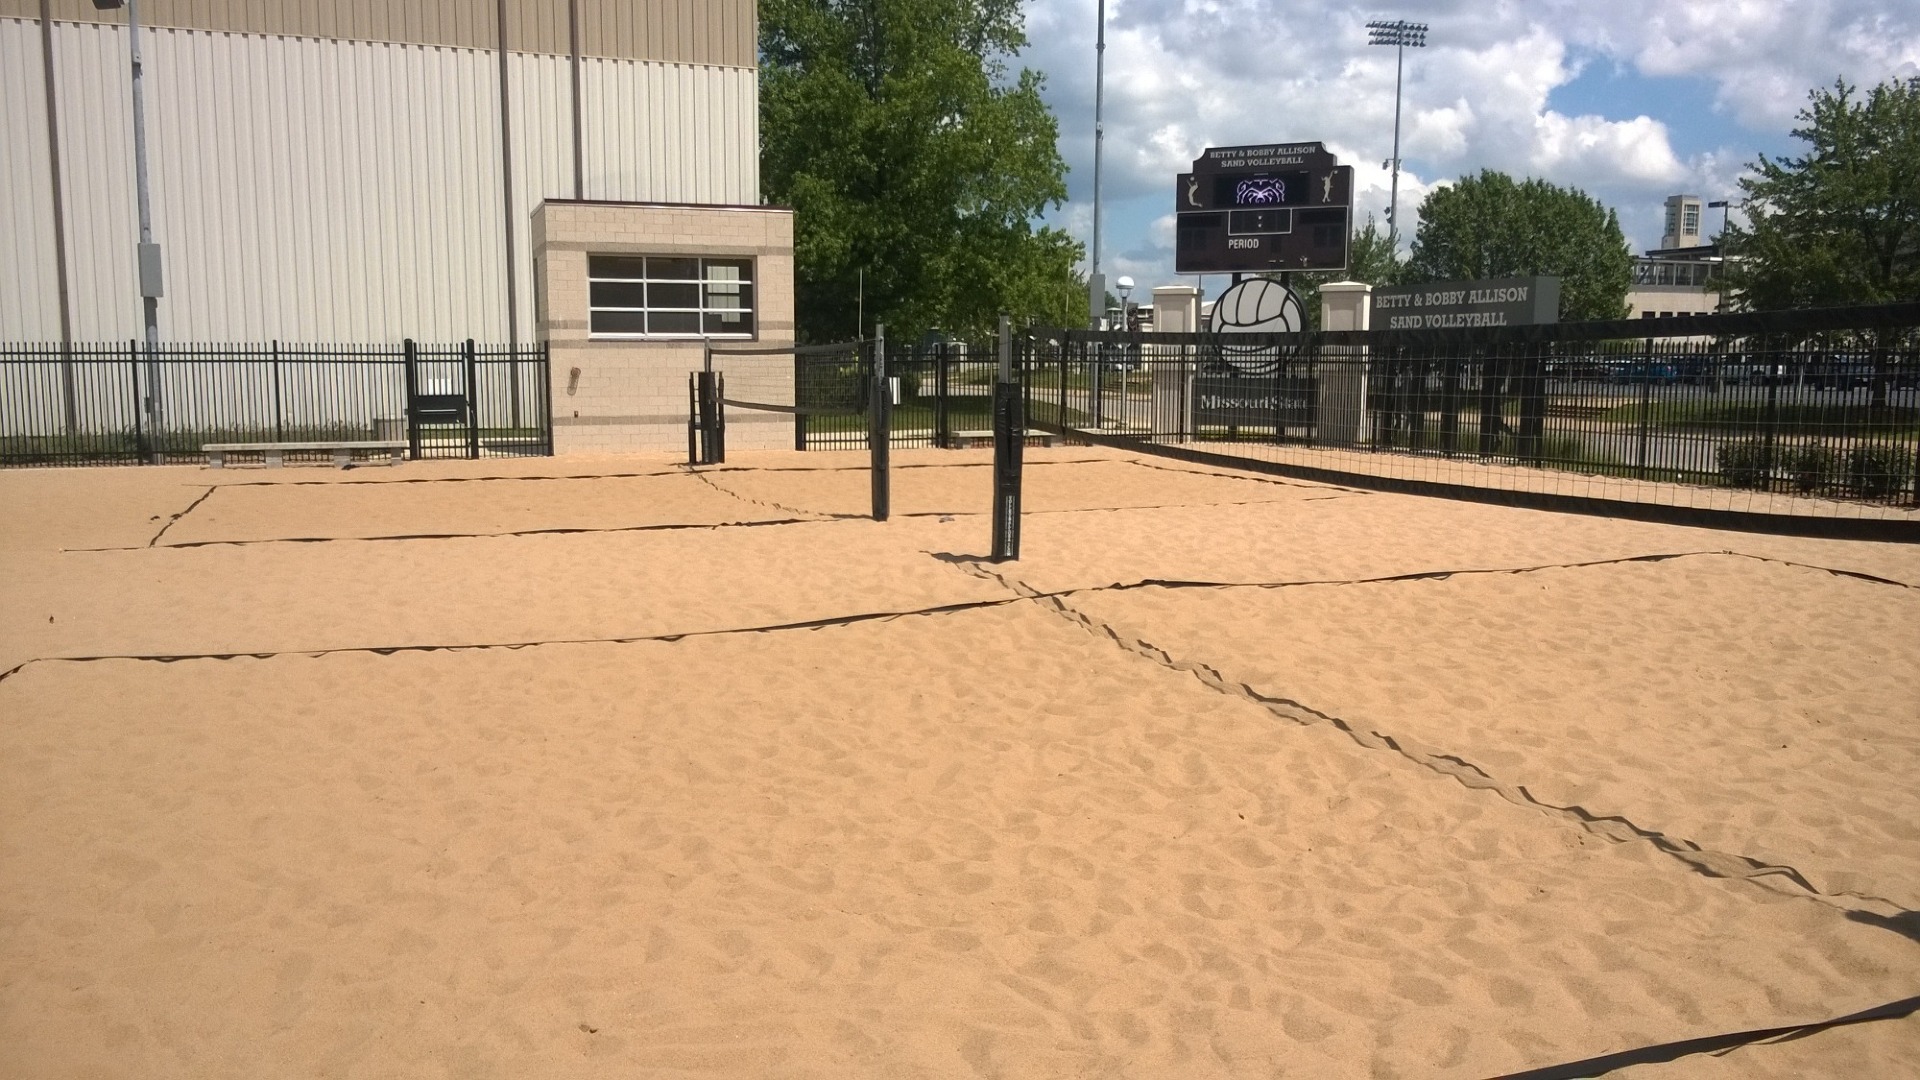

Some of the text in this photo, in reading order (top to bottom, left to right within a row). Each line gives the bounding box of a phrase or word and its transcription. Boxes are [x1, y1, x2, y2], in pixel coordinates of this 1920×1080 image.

[1210, 150, 1237, 159] BETTY
[1247, 148, 1275, 157] BOBBY
[1276, 146, 1316, 155] ALLISON
[1221, 156, 1304, 168] SAND VOLLEYBALL
[1228, 238, 1260, 249] PERIOD
[1375, 286, 1529, 309] BETTY & BOBBY ALLISON
[1390, 312, 1507, 329] SAND VOLLEYBALL
